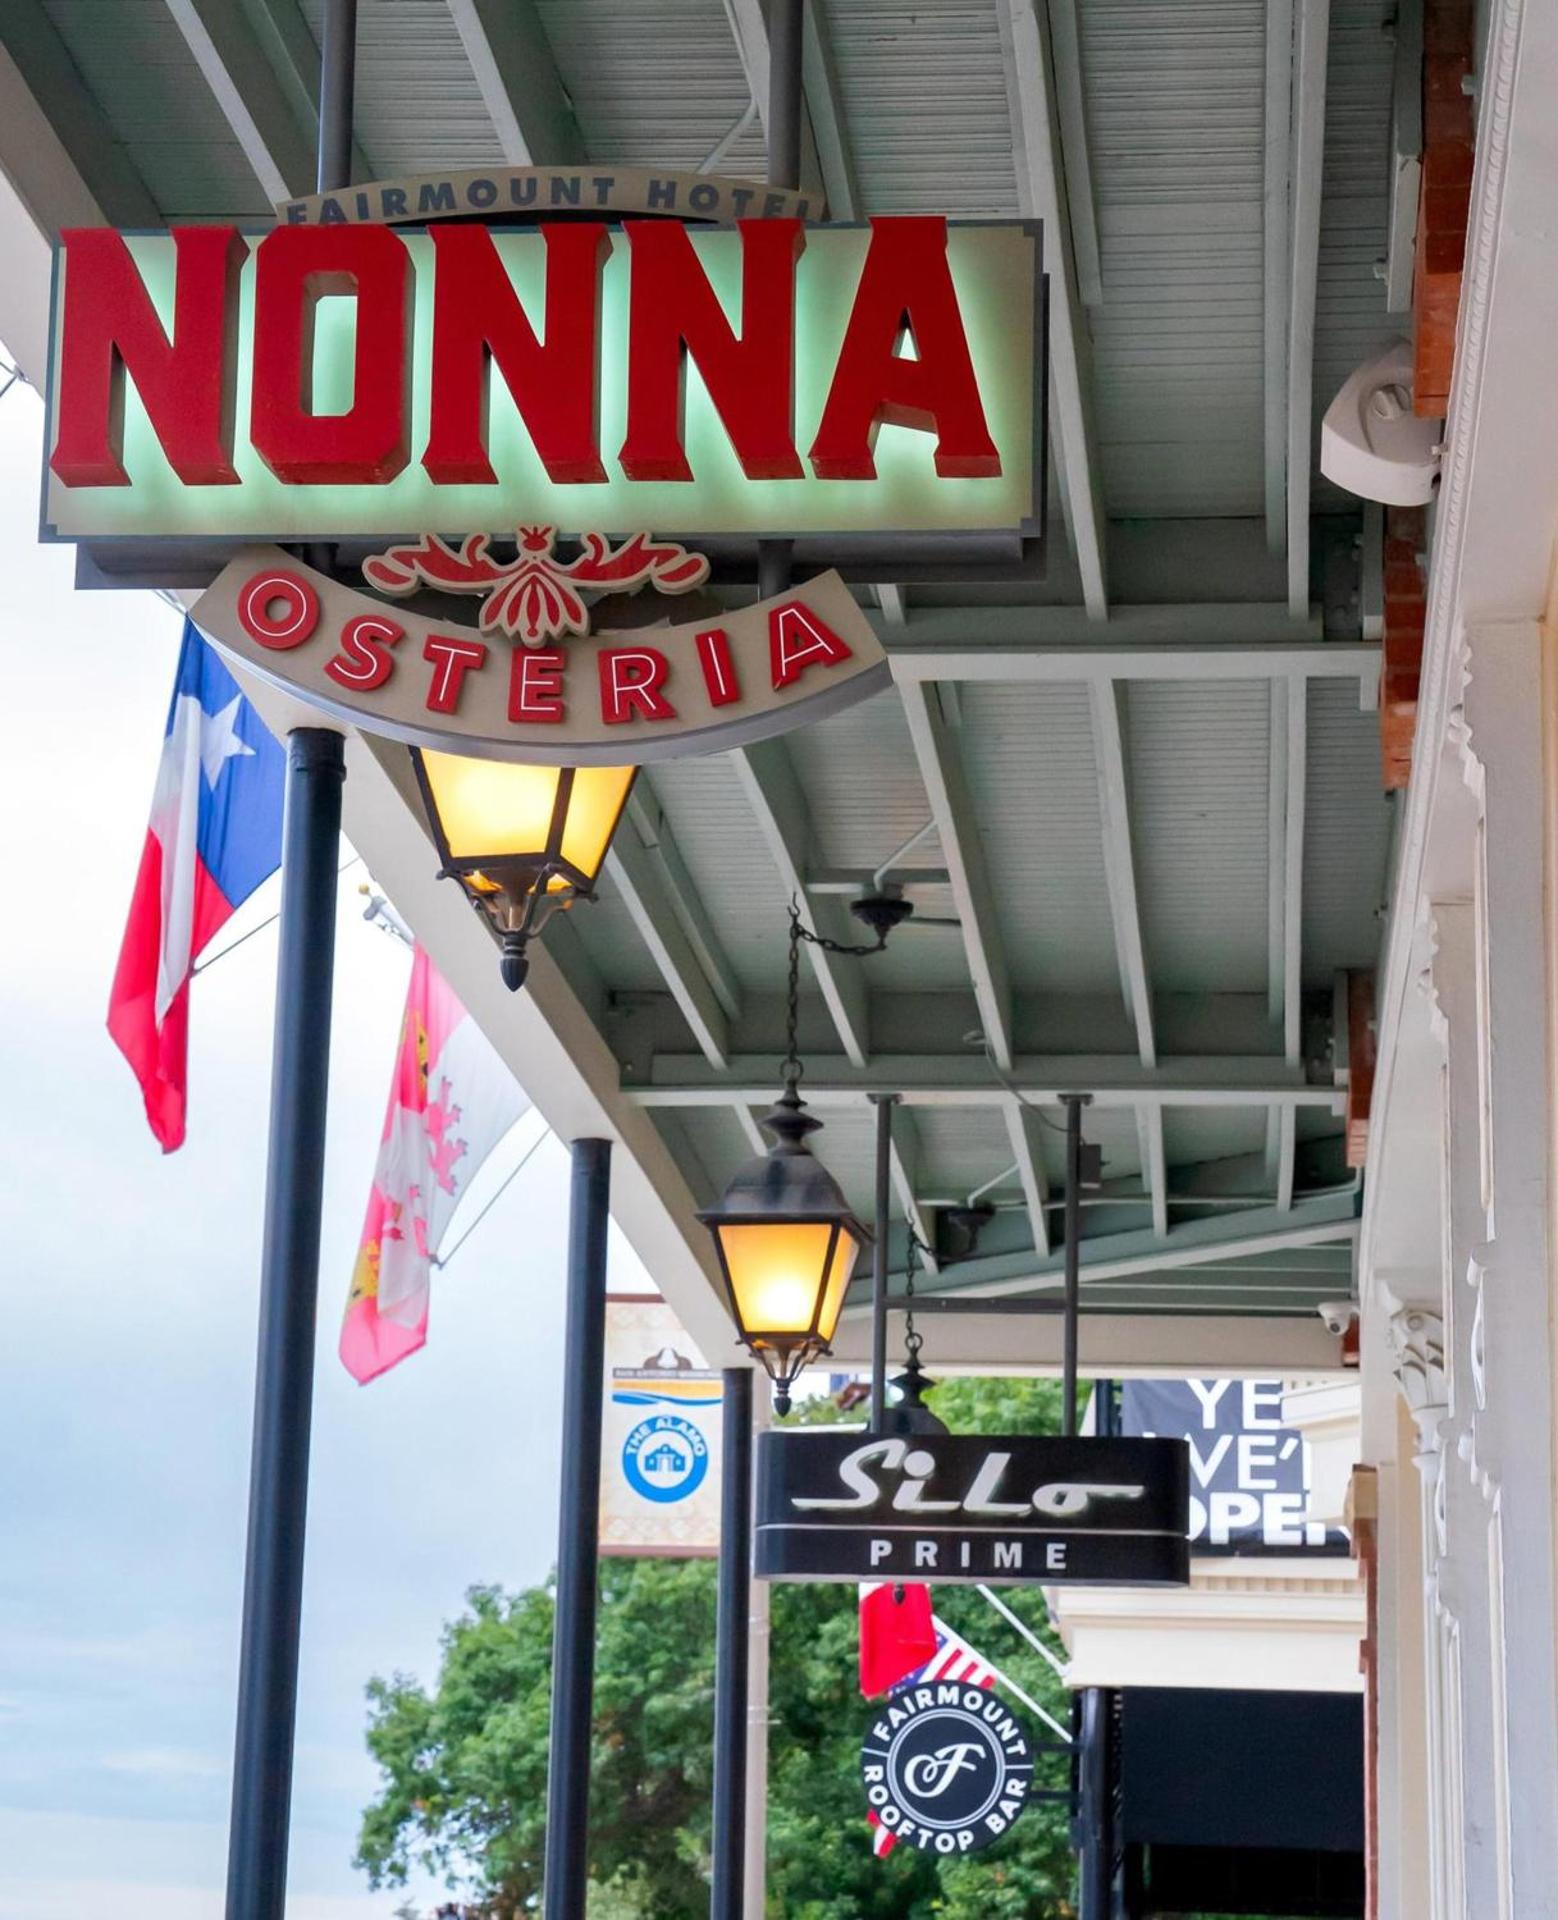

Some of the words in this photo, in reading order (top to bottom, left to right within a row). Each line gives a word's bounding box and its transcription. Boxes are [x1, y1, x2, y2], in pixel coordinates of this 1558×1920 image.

[287, 177, 615, 224] FAIRMOUNT
[50, 215, 1002, 486] NONNA
[237, 569, 852, 724] OSTERIA
[1186, 1379, 1283, 1430] YE
[626, 1423, 651, 1455] THE
[655, 1416, 707, 1457] ALAMO
[870, 1540, 1067, 1569] PRIME
[873, 1685, 1027, 1756] FAIRMOUNT
[864, 1765, 974, 1853] ROOFTOP
[985, 1778, 1027, 1835] BAR
